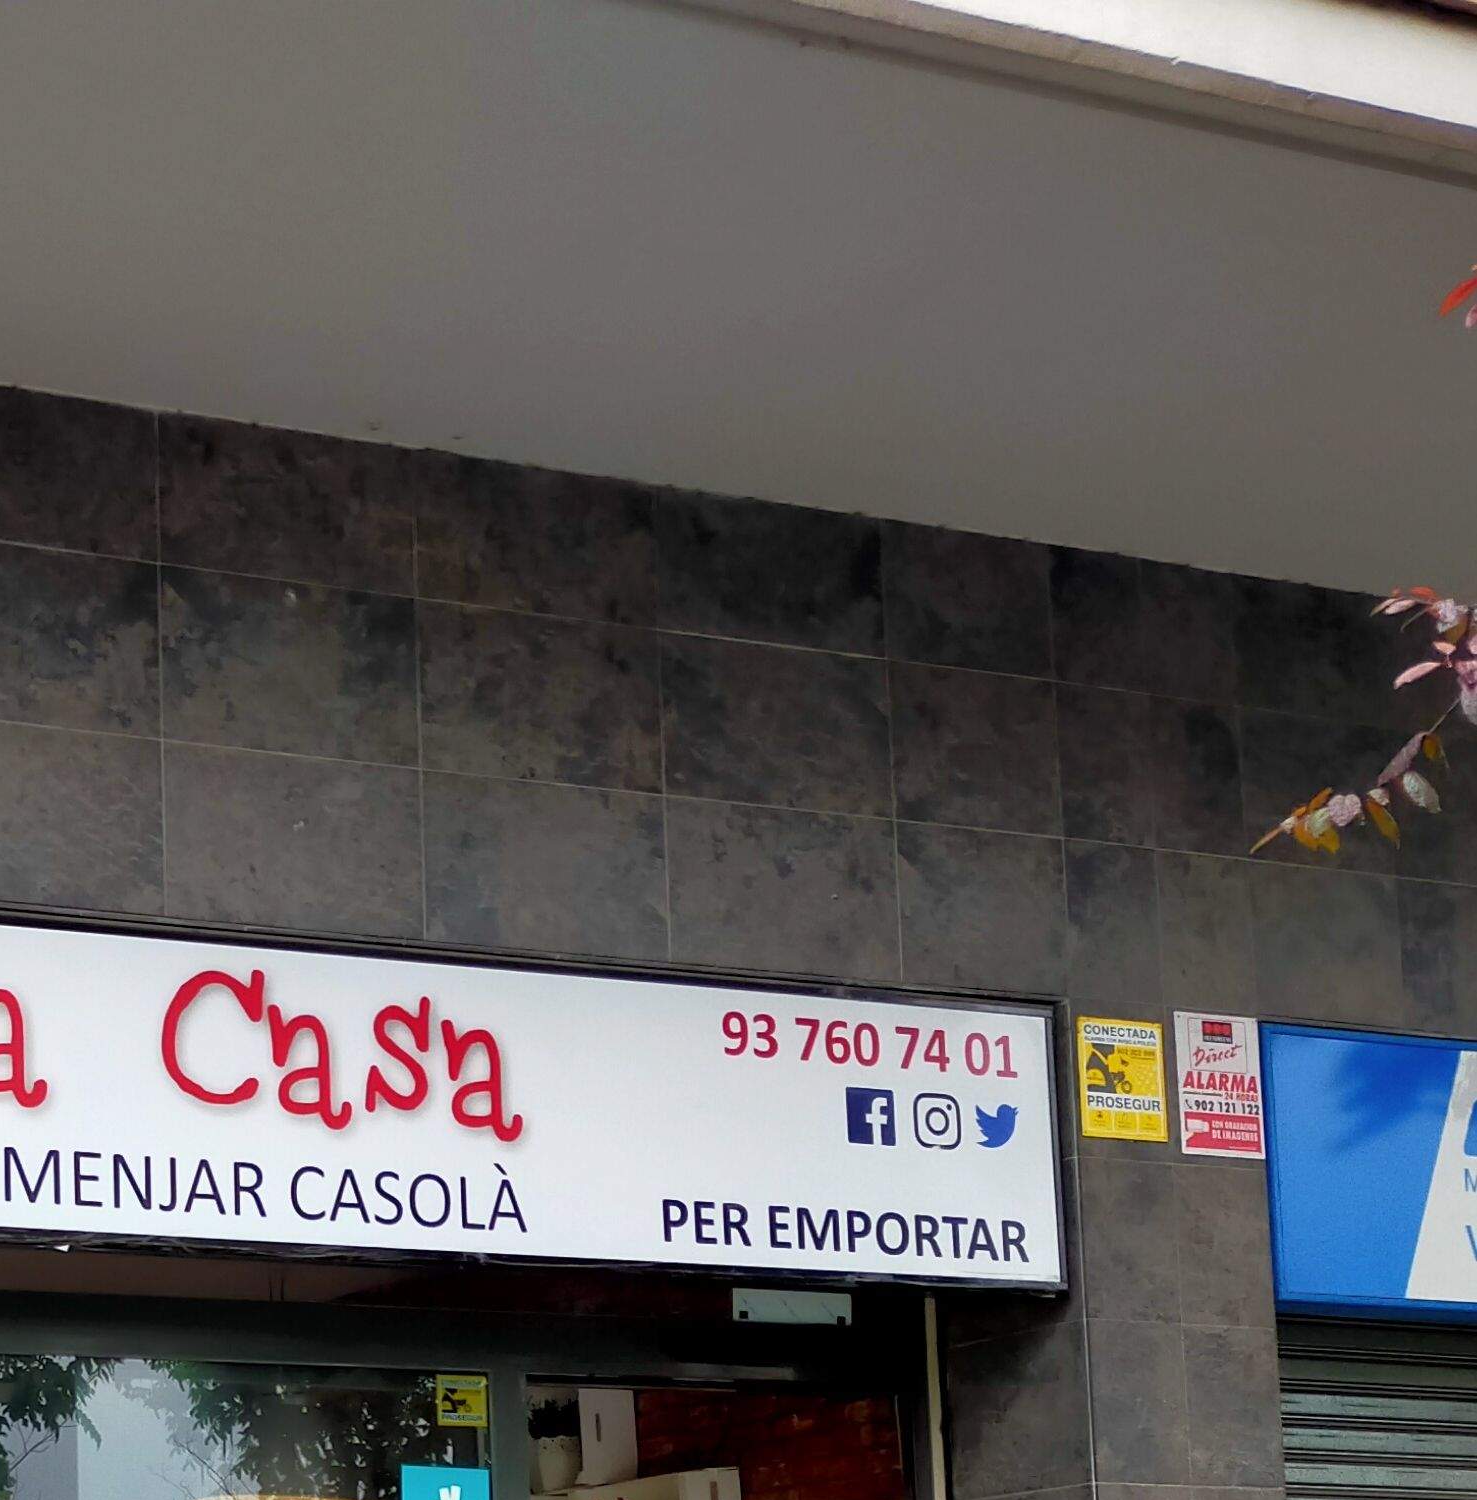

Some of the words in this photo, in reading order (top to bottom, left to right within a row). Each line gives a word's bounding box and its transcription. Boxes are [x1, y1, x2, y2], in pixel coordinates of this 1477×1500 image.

[1084, 1024, 1156, 1040] CONECTADA
[160, 968, 524, 1143] Casa
[722, 1010, 779, 1059] 93
[794, 1017, 880, 1067] 760
[894, 1025, 951, 1073] 74
[964, 1031, 1018, 1080] 01
[1193, 1044, 1242, 1067] Direct
[1183, 1070, 1258, 1094] ALARMA
[1087, 1095, 1161, 1112] PROSEGUR
[1194, 1100, 1214, 1111] 902
[1218, 1102, 1236, 1113] 121
[1242, 1103, 1260, 1115] 122
[2, 1144, 264, 1218] MENJAR
[288, 1162, 527, 1234] CASOLÀ
[662, 1199, 750, 1249] PER
[768, 1205, 1030, 1264] EMPORTAR
